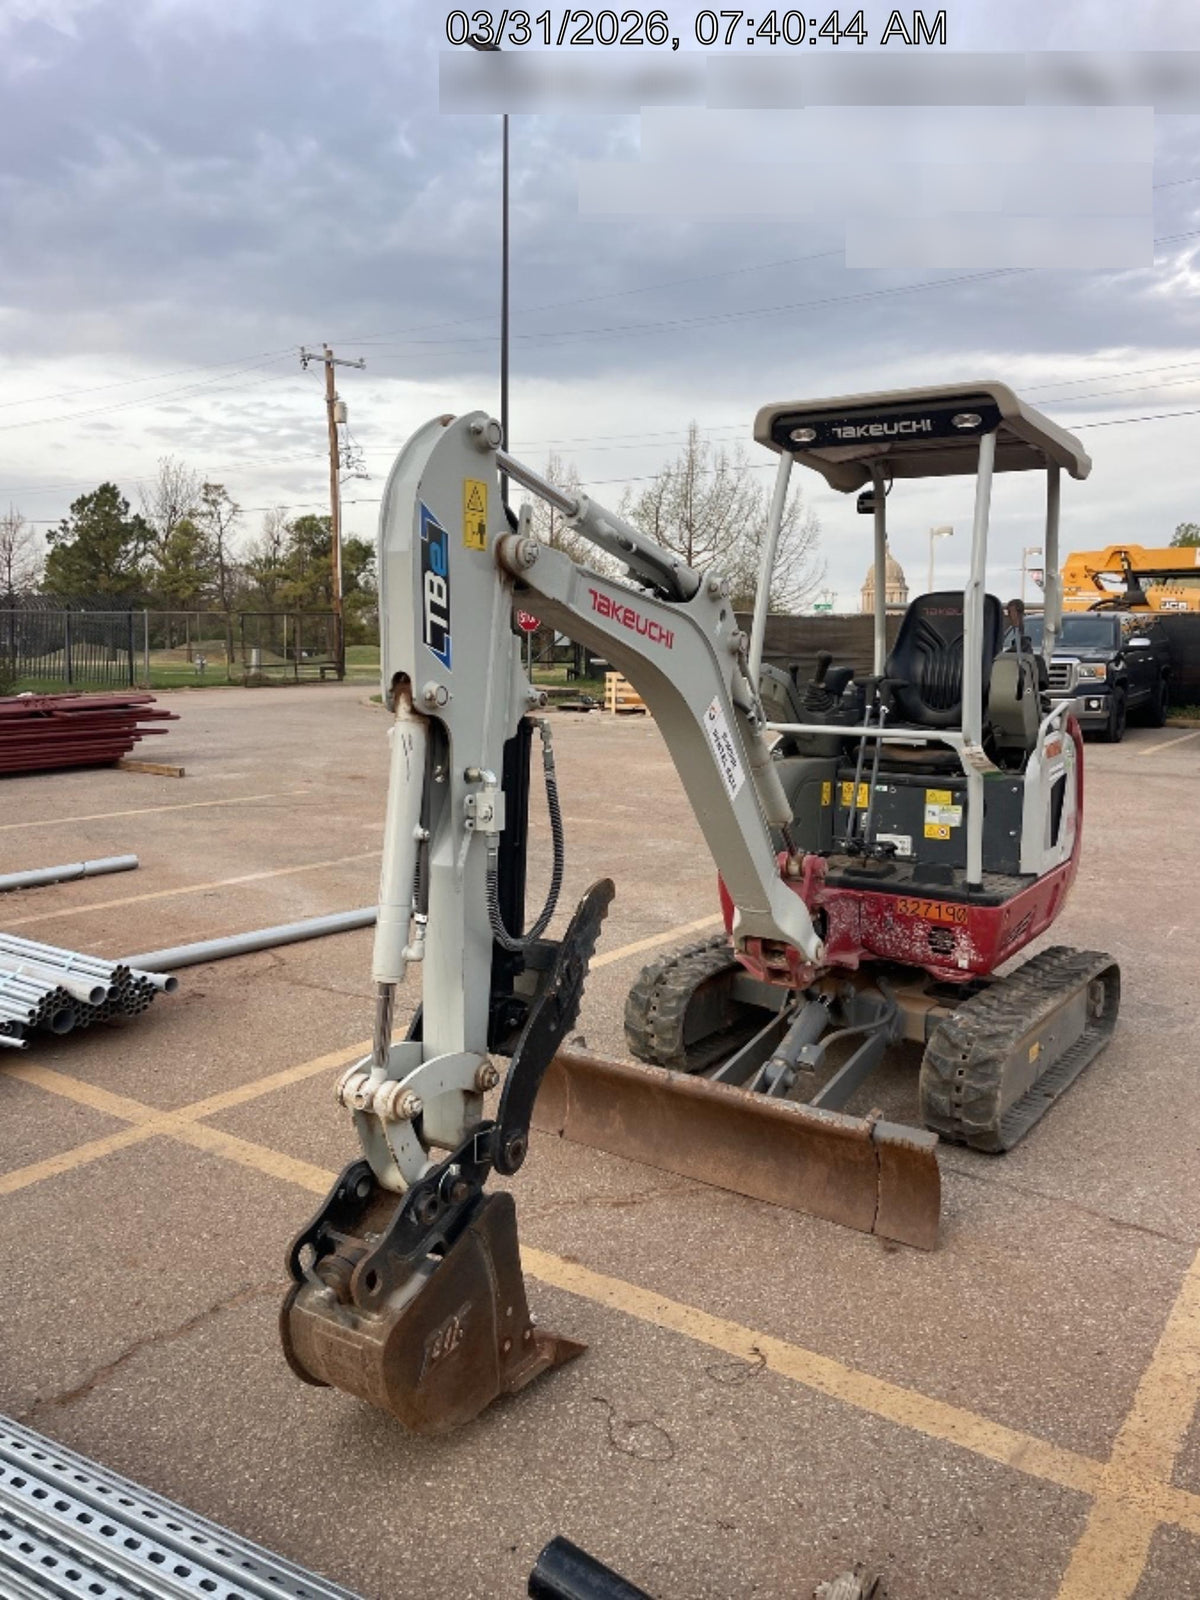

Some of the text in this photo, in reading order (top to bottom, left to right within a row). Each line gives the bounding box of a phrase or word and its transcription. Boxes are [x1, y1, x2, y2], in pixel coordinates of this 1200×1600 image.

[832, 419, 932, 438] TAKEUCHI
[588, 587, 675, 649] TAKEUCHI
[899, 899, 967, 923] 327190
